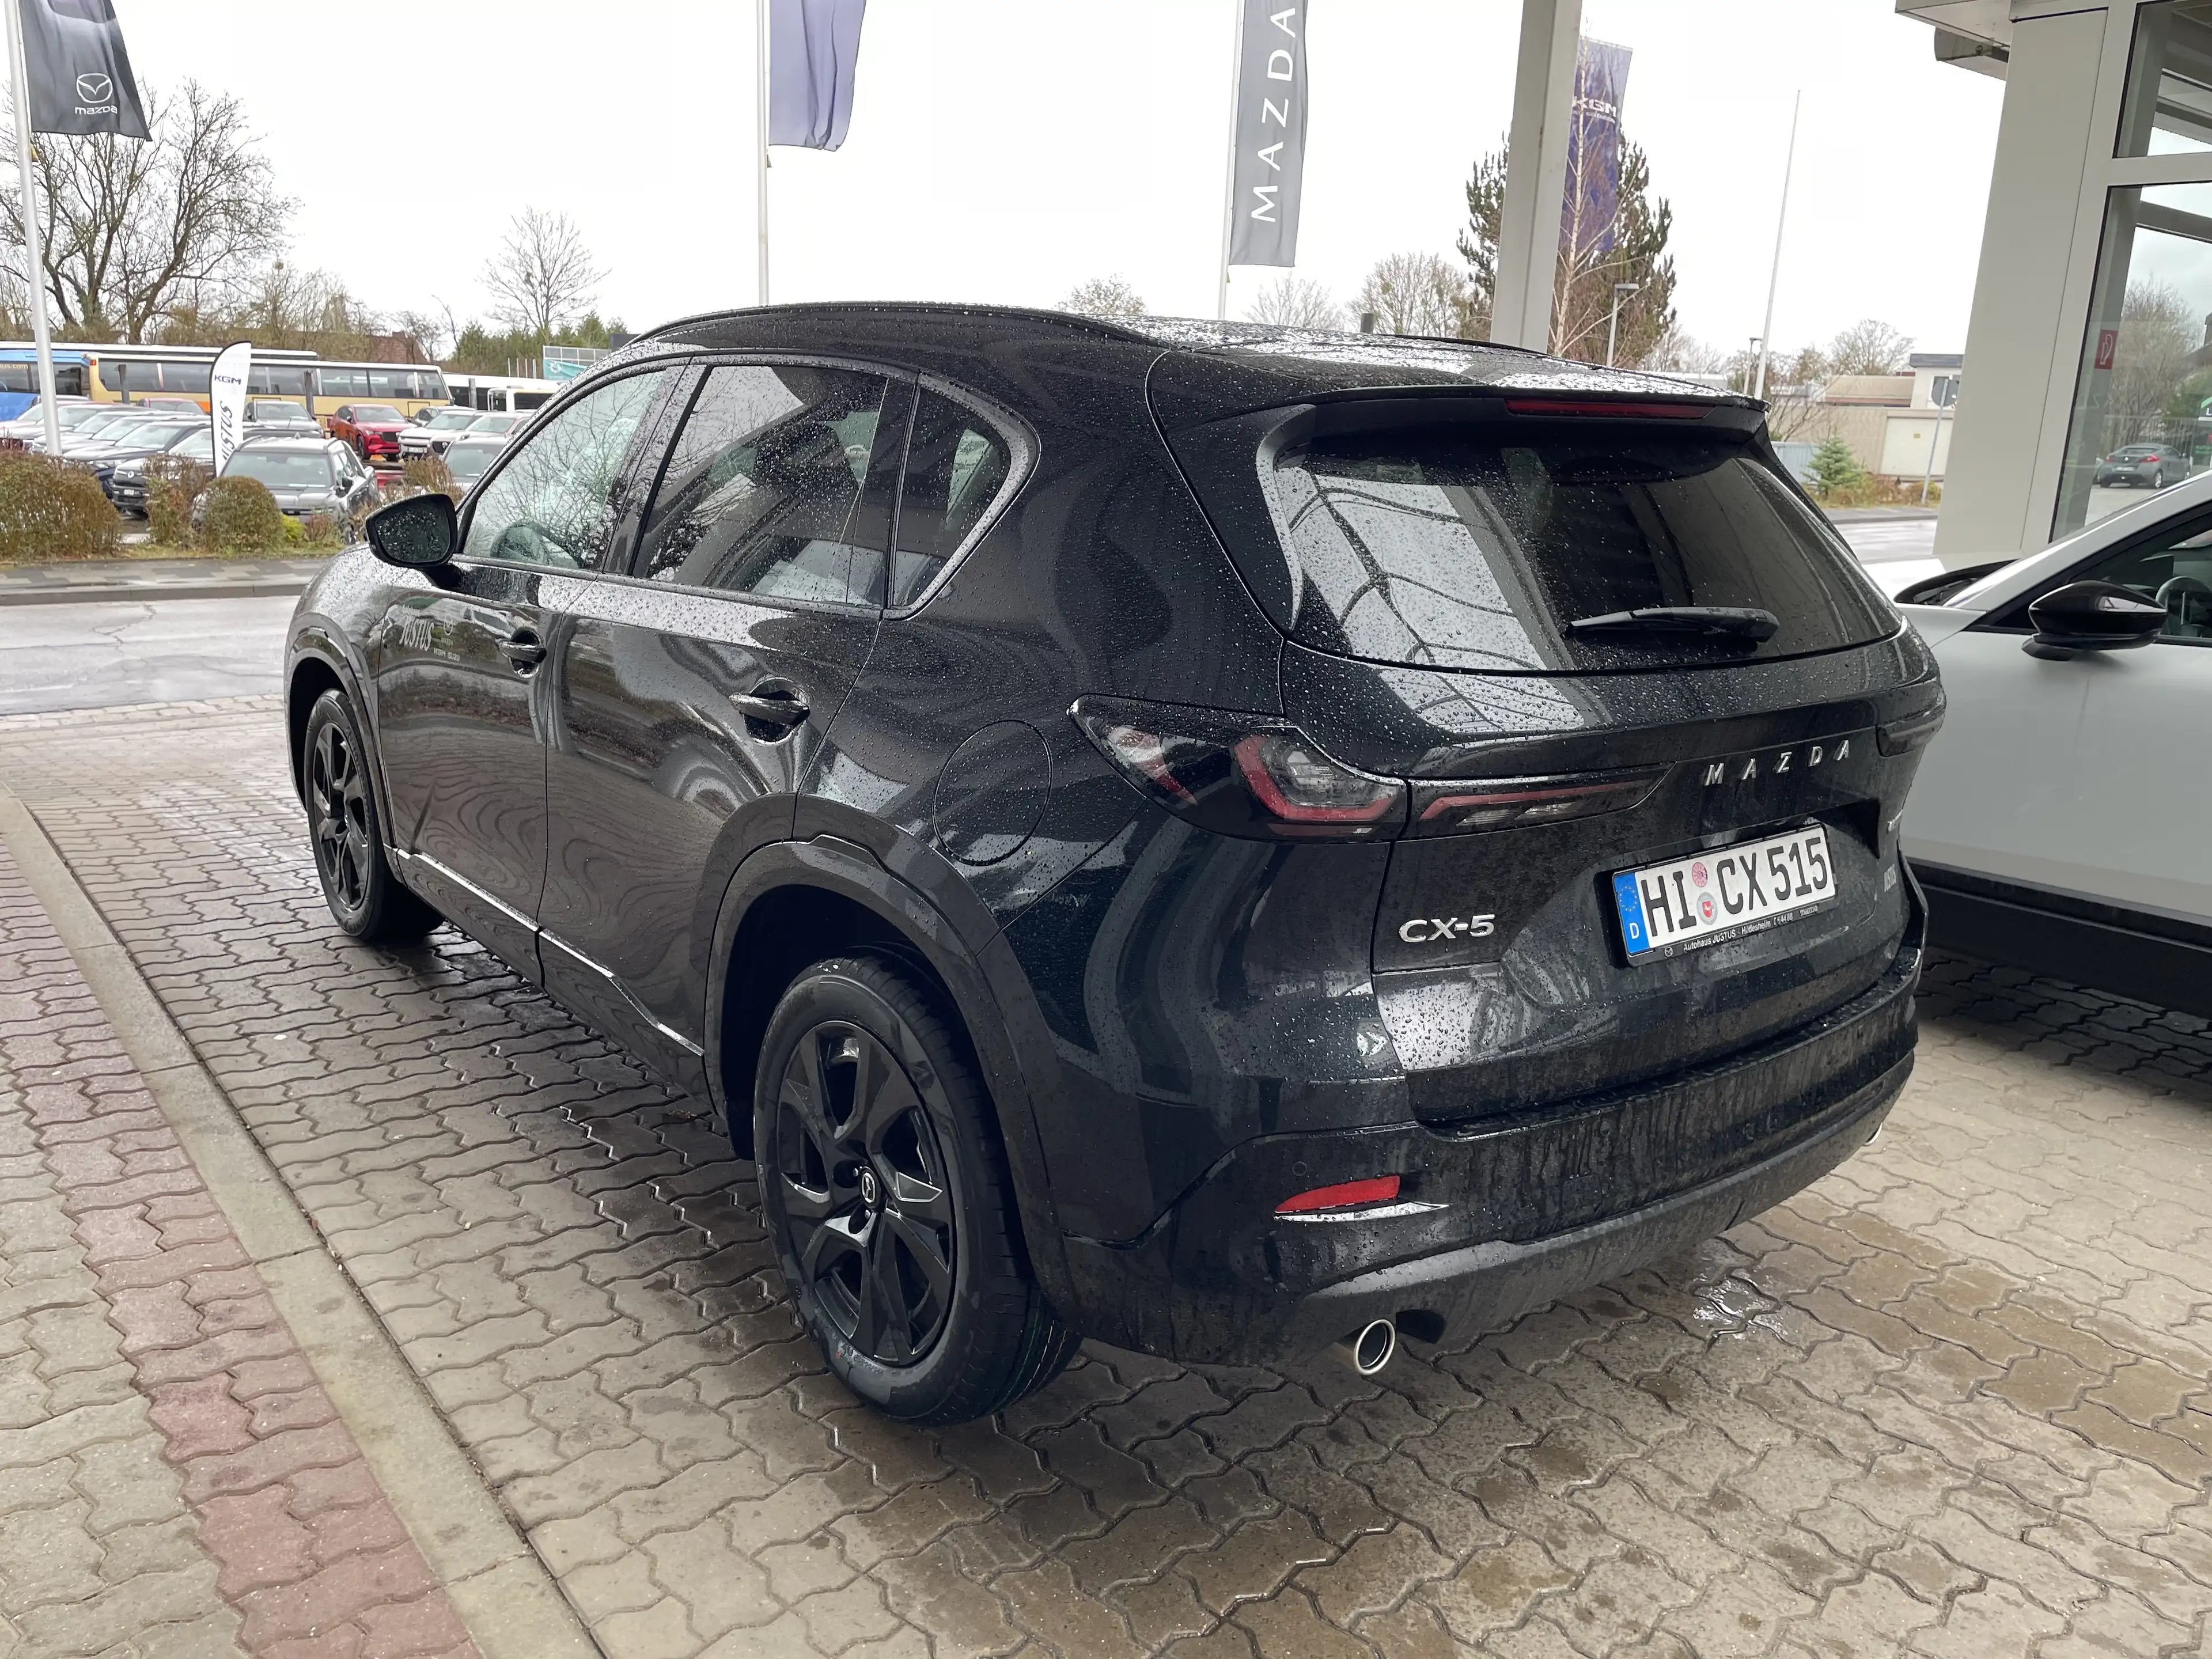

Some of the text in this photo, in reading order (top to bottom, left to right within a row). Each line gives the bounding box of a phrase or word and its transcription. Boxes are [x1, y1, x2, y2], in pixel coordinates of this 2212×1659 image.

[1251, 7, 1296, 222] MAZDA
[1572, 96, 1616, 118] KGM
[214, 374, 241, 385] KGM
[399, 615, 434, 652] JUSTUS
[433, 647, 446, 657] KGM
[1705, 740, 1850, 786] MAZDA
[1641, 870, 1697, 937] HI
[1399, 914, 1495, 942] CX-5
[1629, 922, 1640, 940] D
[1683, 938, 1711, 952] Autohaus
[1713, 929, 1736, 944] JUSTUS
[1741, 921, 1771, 935] Hildesheim
